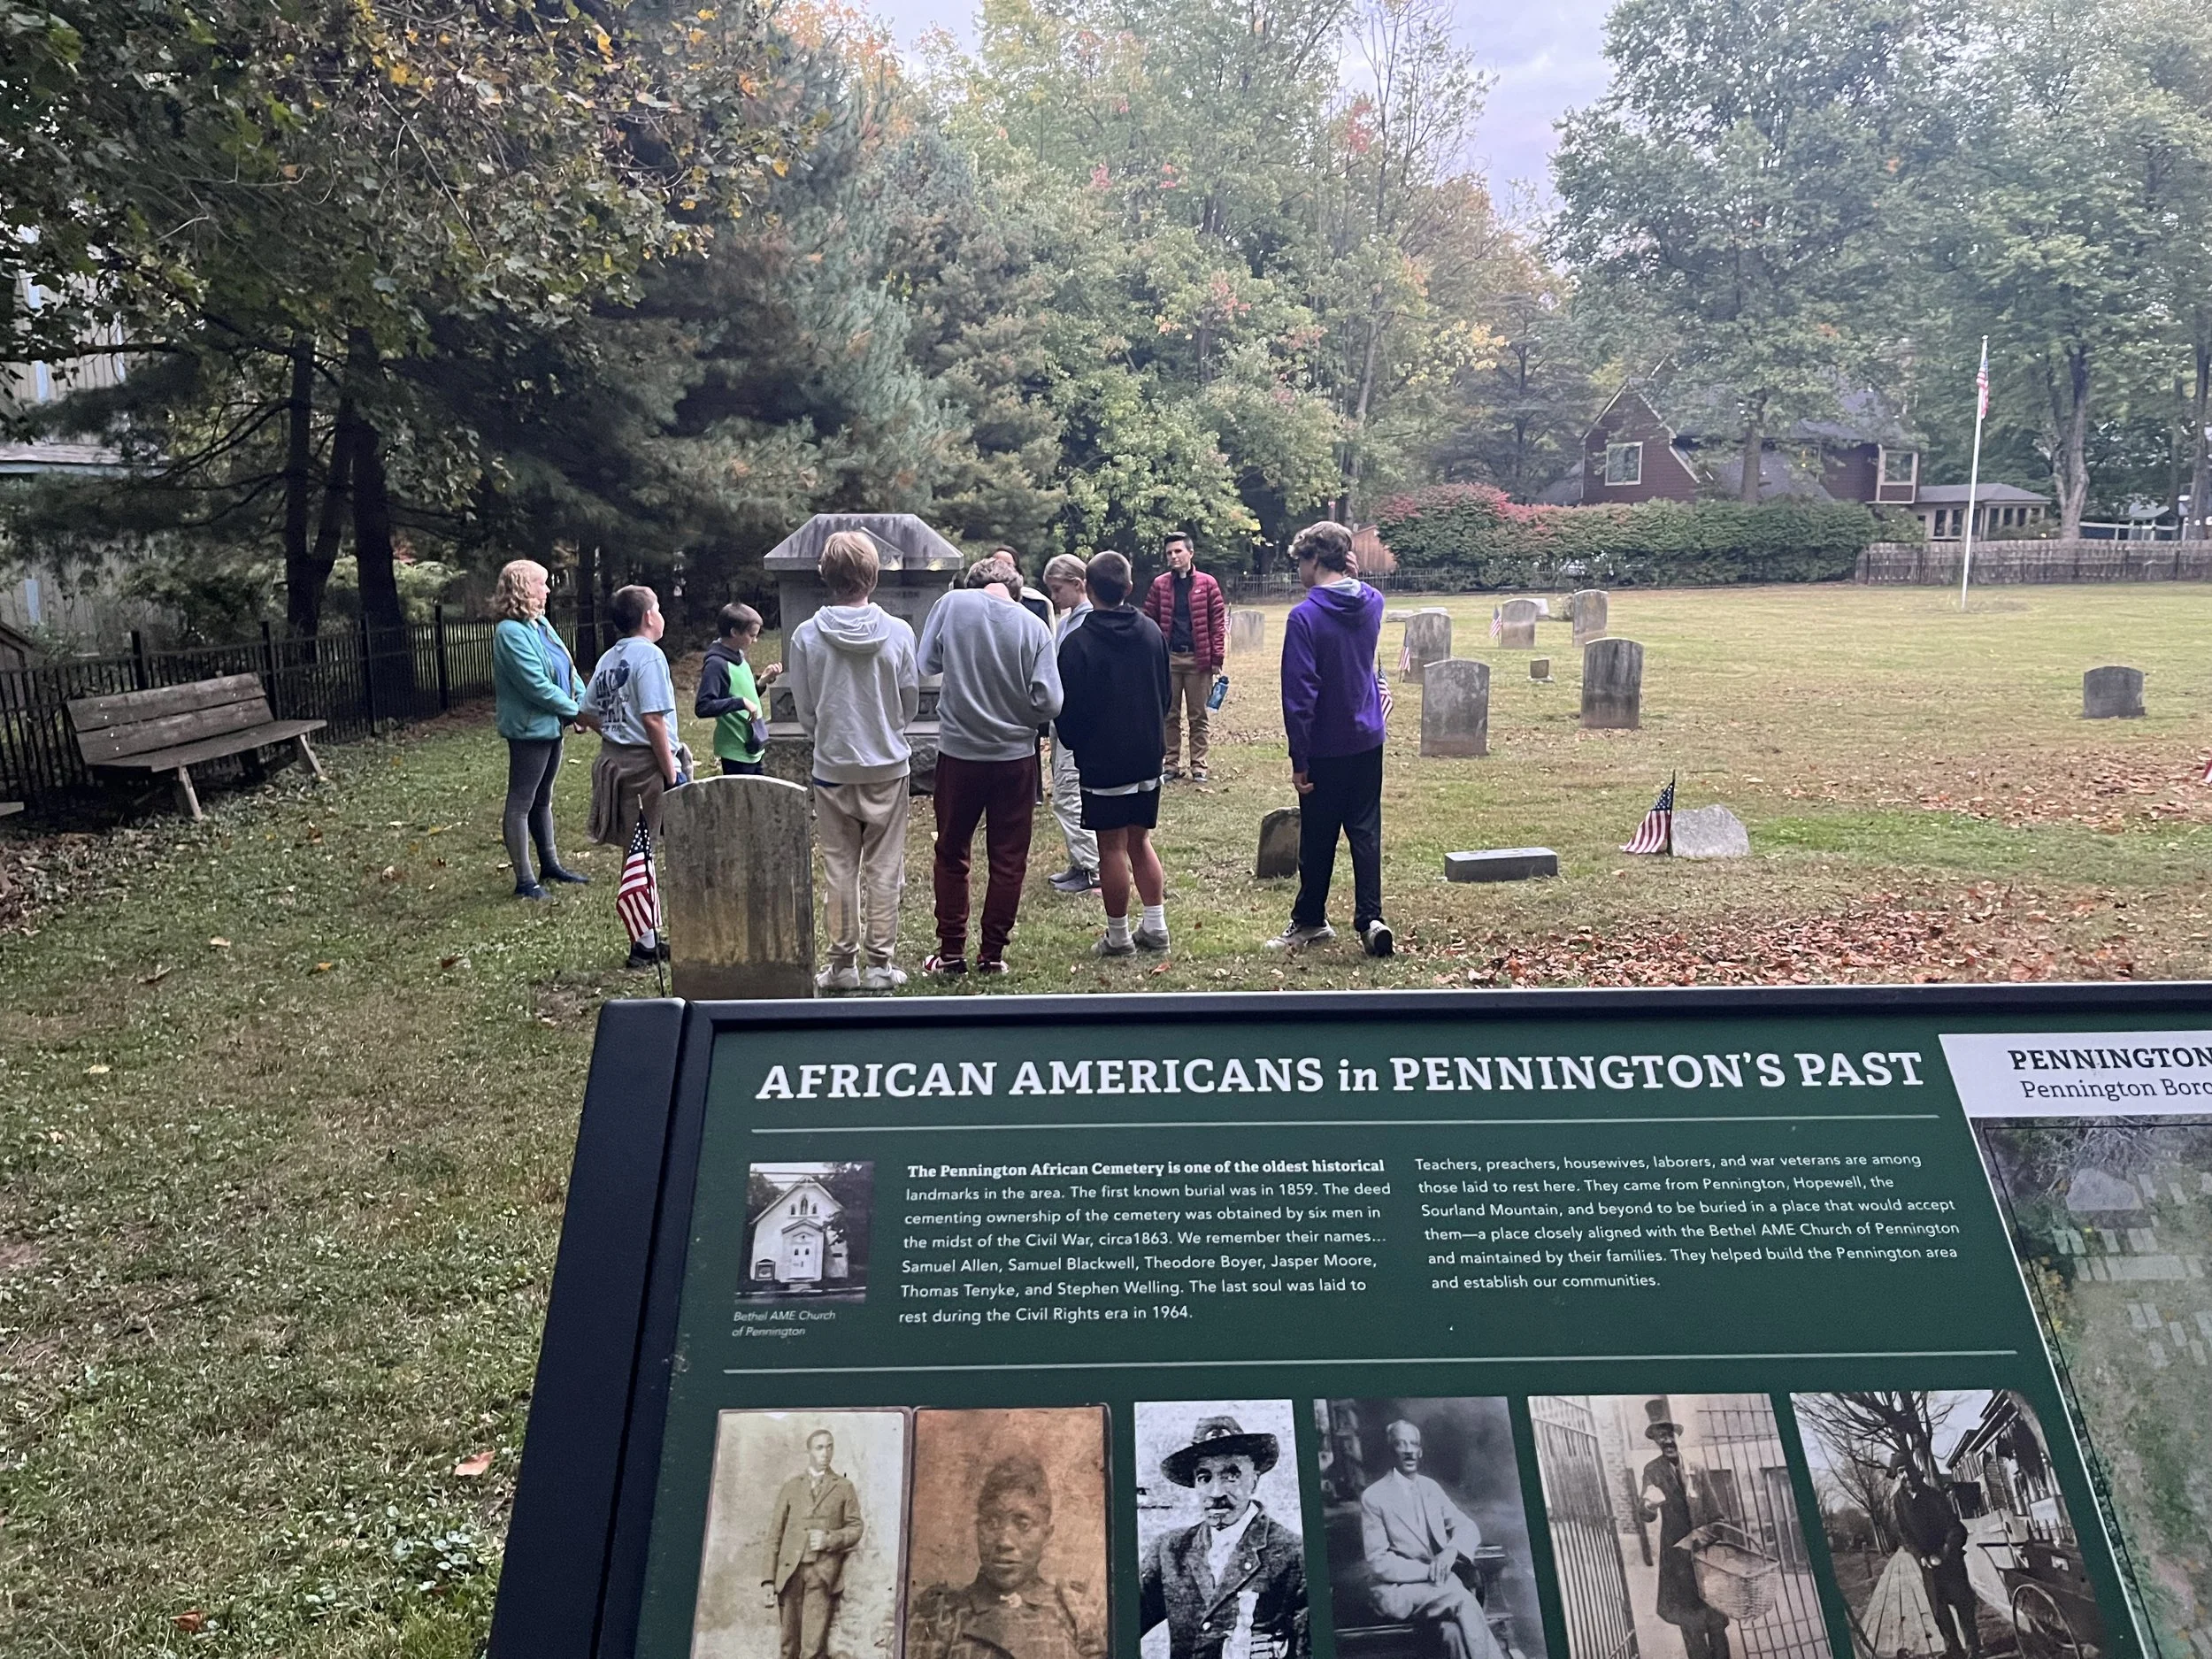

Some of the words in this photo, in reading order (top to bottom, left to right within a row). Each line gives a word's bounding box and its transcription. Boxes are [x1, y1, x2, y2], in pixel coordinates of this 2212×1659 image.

[2008, 1047, 2212, 1070] PENNINGTON
[756, 1062, 997, 1099] AFRICAN
[1009, 1058, 1323, 1094] AMERICANS
[1338, 1059, 1379, 1091] in
[1390, 1052, 1785, 1090] PENNINGTON'S
[1794, 1052, 1924, 1087] PAST
[2020, 1079, 2157, 1102] Pennington
[907, 1164, 937, 1178] The
[940, 1164, 1027, 1179] Pennington
[1029, 1162, 1089, 1176] African
[1091, 1162, 1165, 1178] Cemetery
[1167, 1160, 1181, 1174] is
[1183, 1164, 1211, 1174] one
[1214, 1160, 1232, 1173] of
[1233, 1160, 1259, 1173] the
[1262, 1160, 1310, 1173] oldest
[1311, 1158, 1385, 1172] historical
[1414, 1157, 1482, 1172] Teachers,
[1486, 1156, 1560, 1173] preachers,
[1563, 1156, 1650, 1170] housewives,
[1653, 1155, 1716, 1169] laborers,
[1720, 1154, 1747, 1167] and
[1749, 1157, 1775, 1166] war
[1779, 1156, 1841, 1166] veterans
[1845, 1156, 1868, 1165] are
[1871, 1156, 1922, 1168] among
[906, 1187, 979, 1201] landmarks
[984, 1187, 997, 1200] in
[1002, 1187, 1025, 1200] the
[1030, 1189, 1065, 1199] area.
[1070, 1185, 1097, 1198] The
[1102, 1185, 1129, 1198] first
[1133, 1185, 1180, 1197] known
[1185, 1183, 1225, 1197] burial
[1229, 1187, 1257, 1196] was
[1261, 1183, 1274, 1195] in
[1279, 1183, 1318, 1195] 1859.
[1322, 1182, 1349, 1195] The
[1354, 1181, 1391, 1195] deed
[1417, 1180, 1458, 1194] those
[1462, 1179, 1489, 1194] laid
[1492, 1182, 1509, 1193] to
[1512, 1181, 1540, 1193] rest
[1542, 1179, 1580, 1192] here.
[1583, 1179, 1618, 1194] They
[1623, 1181, 1662, 1192] came
[1664, 1178, 1699, 1190] from
[1702, 1178, 1790, 1193] Pennington,
[1793, 1175, 1867, 1192] Hopewell,
[1870, 1175, 1894, 1188] the
[904, 1211, 982, 1227] cementing
[987, 1210, 1061, 1225] ownership
[1065, 1208, 1081, 1222] of
[1085, 1208, 1109, 1222] the
[1113, 1210, 1181, 1224] cemetery
[1185, 1210, 1213, 1220] was
[1217, 1206, 1282, 1220] obtained
[1286, 1206, 1304, 1223] by
[1308, 1206, 1328, 1219] six
[1332, 1209, 1363, 1218] men
[1367, 1206, 1381, 1218] in
[1421, 1202, 1486, 1217] Sourland
[1489, 1203, 1563, 1217] Mountain,
[1567, 1202, 1594, 1215] and
[1597, 1201, 1653, 1218] beyond
[1656, 1203, 1673, 1214] to
[1676, 1201, 1696, 1214] be
[1699, 1199, 1747, 1213] buried
[1750, 1200, 1765, 1212] in
[1769, 1202, 1778, 1212] a
[1781, 1199, 1820, 1215] place
[1824, 1199, 1855, 1212] that
[1857, 1197, 1903, 1211] would
[1907, 1200, 1956, 1213] accept
[903, 1235, 927, 1248] the
[932, 1234, 972, 1248] midst
[977, 1233, 994, 1248] of
[997, 1233, 1021, 1247] the
[1025, 1233, 1057, 1247] Civil
[1061, 1233, 1094, 1248] War,
[1098, 1231, 1172, 1246] circa1863.
[1177, 1231, 1202, 1244] We
[1206, 1230, 1281, 1244] remember
[1286, 1229, 1319, 1243] their
[1491, 1226, 1530, 1243] place
[1533, 1225, 1583, 1242] closely
[1588, 1225, 1642, 1242] aligned
[1645, 1224, 1677, 1238] with
[1680, 1224, 1705, 1238] the
[1709, 1223, 1756, 1237] Bethel
[1761, 1223, 1797, 1236] AME
[1799, 1222, 1852, 1236] Church
[1856, 1221, 1871, 1235] of
[1875, 1222, 1960, 1238] Pennington
[902, 1259, 956, 1273] Samuel
[960, 1258, 1002, 1273] Allen,
[1008, 1256, 1062, 1271] Samuel
[1066, 1256, 1140, 1271] Blackwell,
[1143, 1255, 1216, 1269] Theodore
[1220, 1255, 1266, 1271] Boyer,
[1271, 1254, 1319, 1271] Jasper
[1324, 1254, 1377, 1268] Moore,
[1428, 1250, 1455, 1264] and
[1460, 1250, 1541, 1264] maintained
[1545, 1250, 1563, 1267] by
[1567, 1249, 1602, 1263] their
[1606, 1248, 1667, 1263] families.
[1670, 1248, 1707, 1264] They
[1710, 1247, 1763, 1263] helped
[1765, 1246, 1804, 1261] build
[1808, 1247, 1832, 1260] the
[1836, 1246, 1922, 1263] Pennington
[1925, 1248, 1958, 1258] area
[900, 1284, 959, 1298] Thomas
[963, 1282, 1020, 1300] Tenyke,
[1025, 1281, 1053, 1296] and
[1057, 1280, 1119, 1298] Stephen
[1123, 1279, 1184, 1297] Welling.
[1188, 1279, 1217, 1293] The
[1221, 1279, 1248, 1293] last
[1252, 1279, 1282, 1293] soul
[1286, 1282, 1315, 1292] was
[1319, 1277, 1346, 1292] laid
[1349, 1280, 1367, 1291] to
[1432, 1275, 1459, 1289] and
[1463, 1274, 1529, 1289] establish
[1532, 1278, 1557, 1288] our
[1562, 1273, 1661, 1287] communities.
[733, 1310, 769, 1322] Bethel
[769, 1310, 797, 1321] AME
[798, 1310, 836, 1321] Church
[899, 1311, 927, 1323] rest
[932, 1309, 981, 1326] during
[986, 1307, 1011, 1322] the
[1015, 1307, 1048, 1321] Civil
[1053, 1306, 1100, 1325] Rights
[1104, 1310, 1128, 1320] era
[1133, 1306, 1147, 1319] in
[1153, 1305, 1193, 1319] 1964.
[732, 1325, 745, 1337] of
[745, 1326, 806, 1339] Pennington
